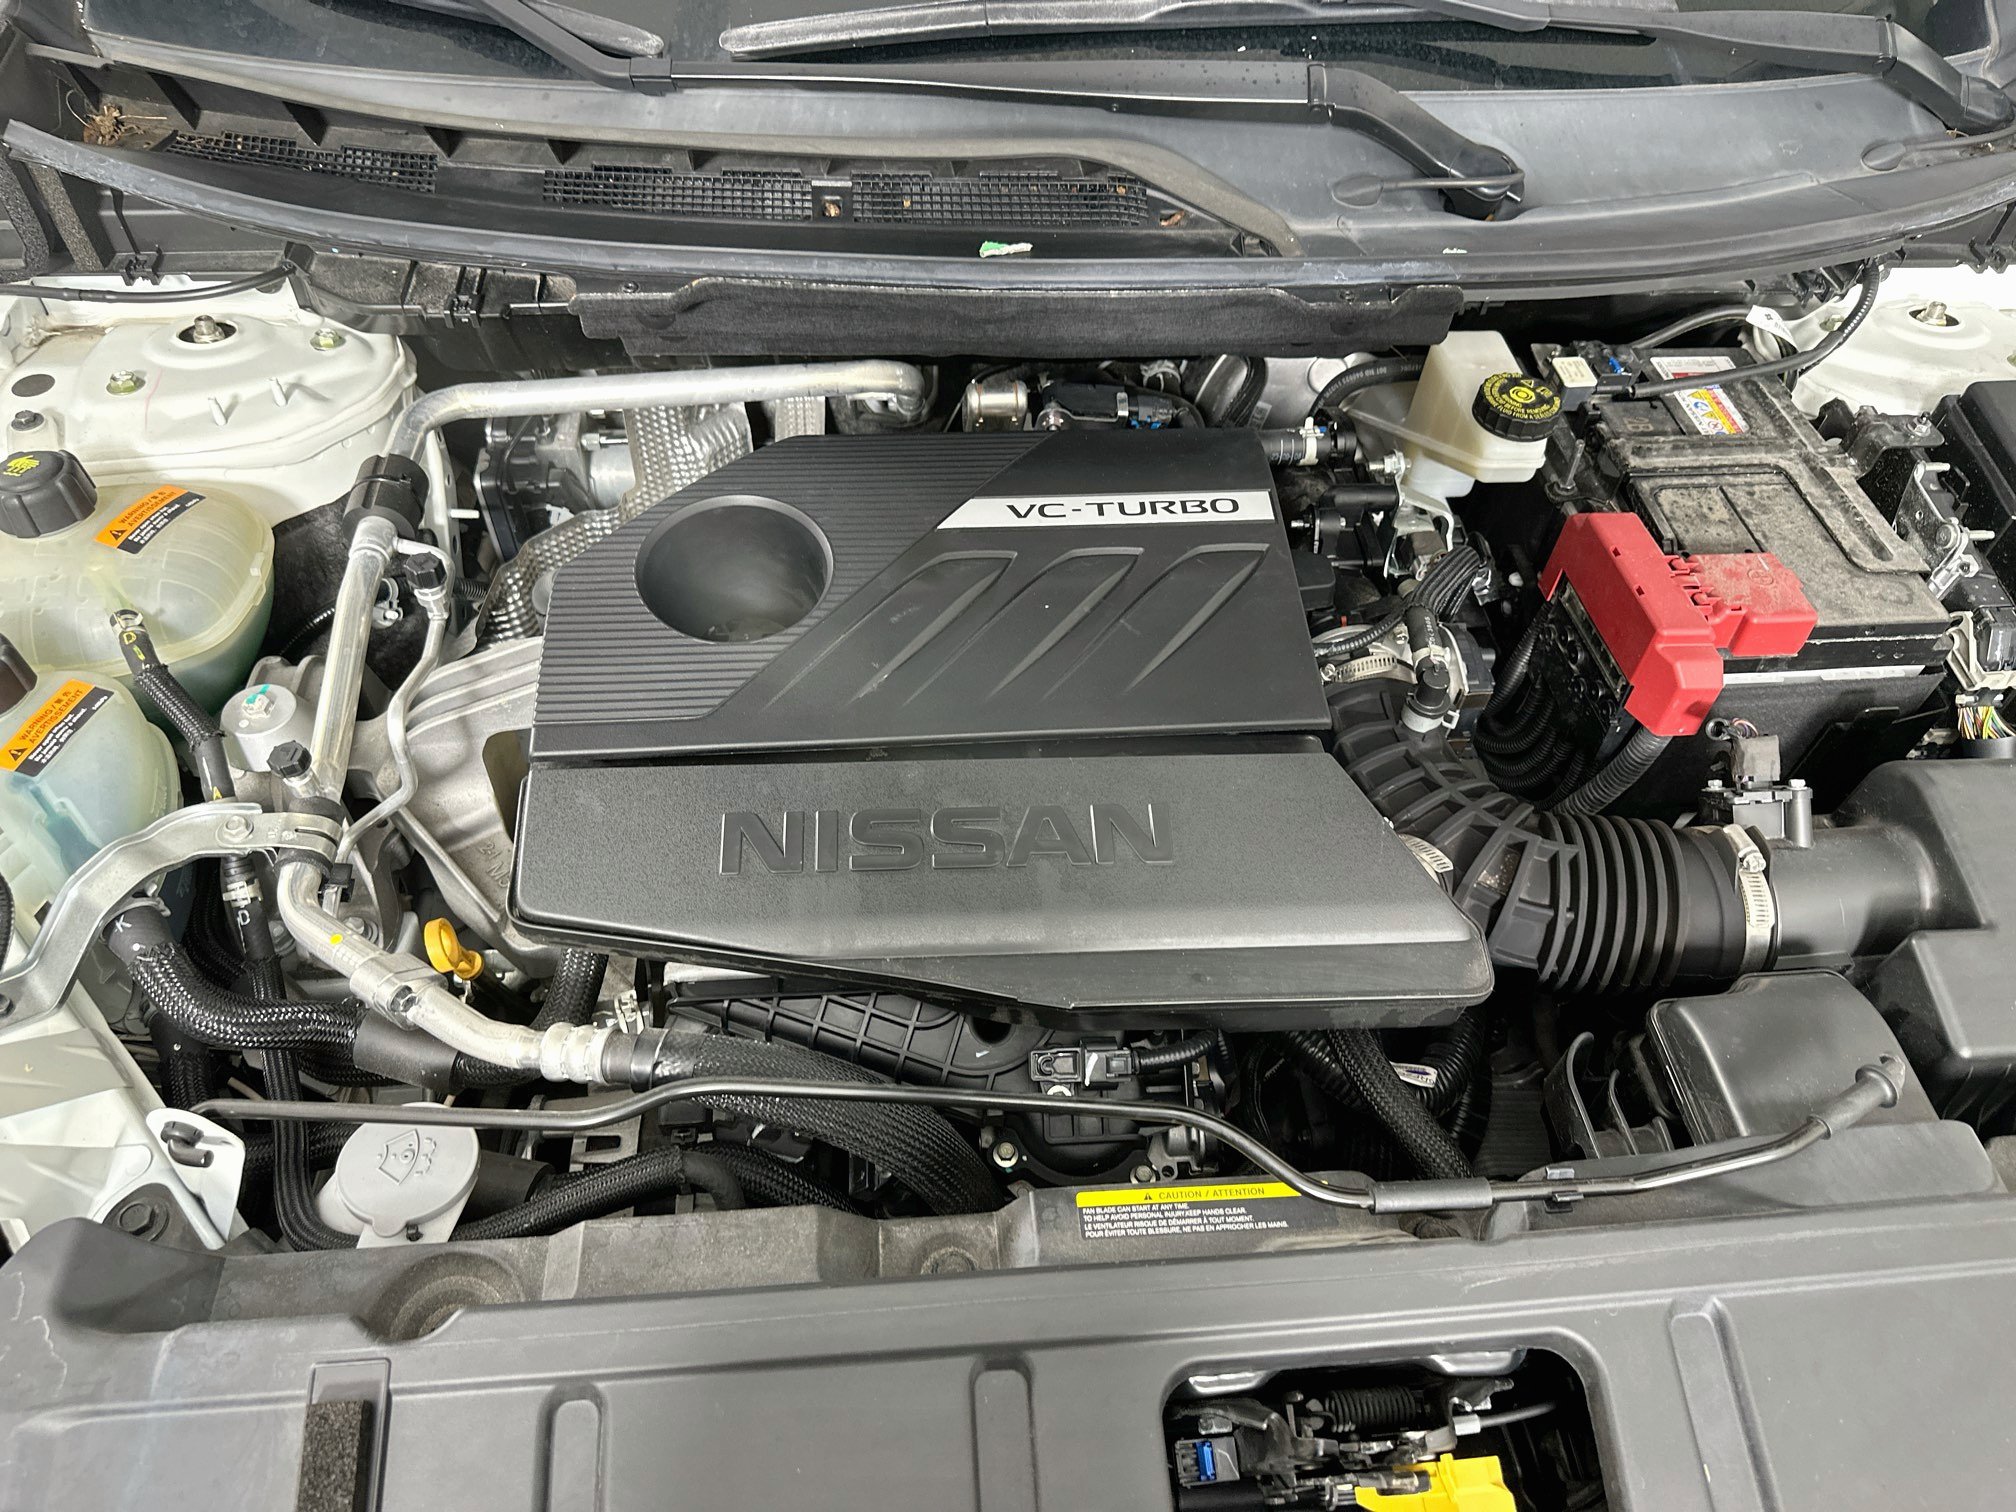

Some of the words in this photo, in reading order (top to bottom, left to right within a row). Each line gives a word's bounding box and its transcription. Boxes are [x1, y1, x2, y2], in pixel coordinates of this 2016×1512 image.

[128, 492, 176, 527] AVERTISSEMENT
[1006, 497, 1240, 519] VC-TURBO
[20, 710, 52, 741] WARNING
[29, 689, 83, 744] AVERTISSEMENT
[718, 803, 1174, 876] NISSAN
[1159, 1191, 1202, 1200] CAUTION
[1212, 1187, 1265, 1197] ATTENTION
[1096, 1206, 1116, 1214] BLADE
[1117, 1205, 1130, 1213] CAN
[1132, 1204, 1151, 1212] START
[1131, 1211, 1163, 1220] PERSONAL
[1202, 1208, 1224, 1216] HANDS
[1085, 1230, 1103, 1238] POUR
[1104, 1229, 1125, 1237] ÉVITER
[1127, 1228, 1147, 1236] TOUTE
[1216, 1223, 1254, 1231] APPROCHER
[1255, 1222, 1266, 1230] LES
[1094, 1221, 1133, 1229] VENTILATEUR
[1134, 1220, 1157, 1228] RISQUE
[1168, 1217, 1202, 1226] DÉMARRER
[1203, 1216, 1209, 1224] À
